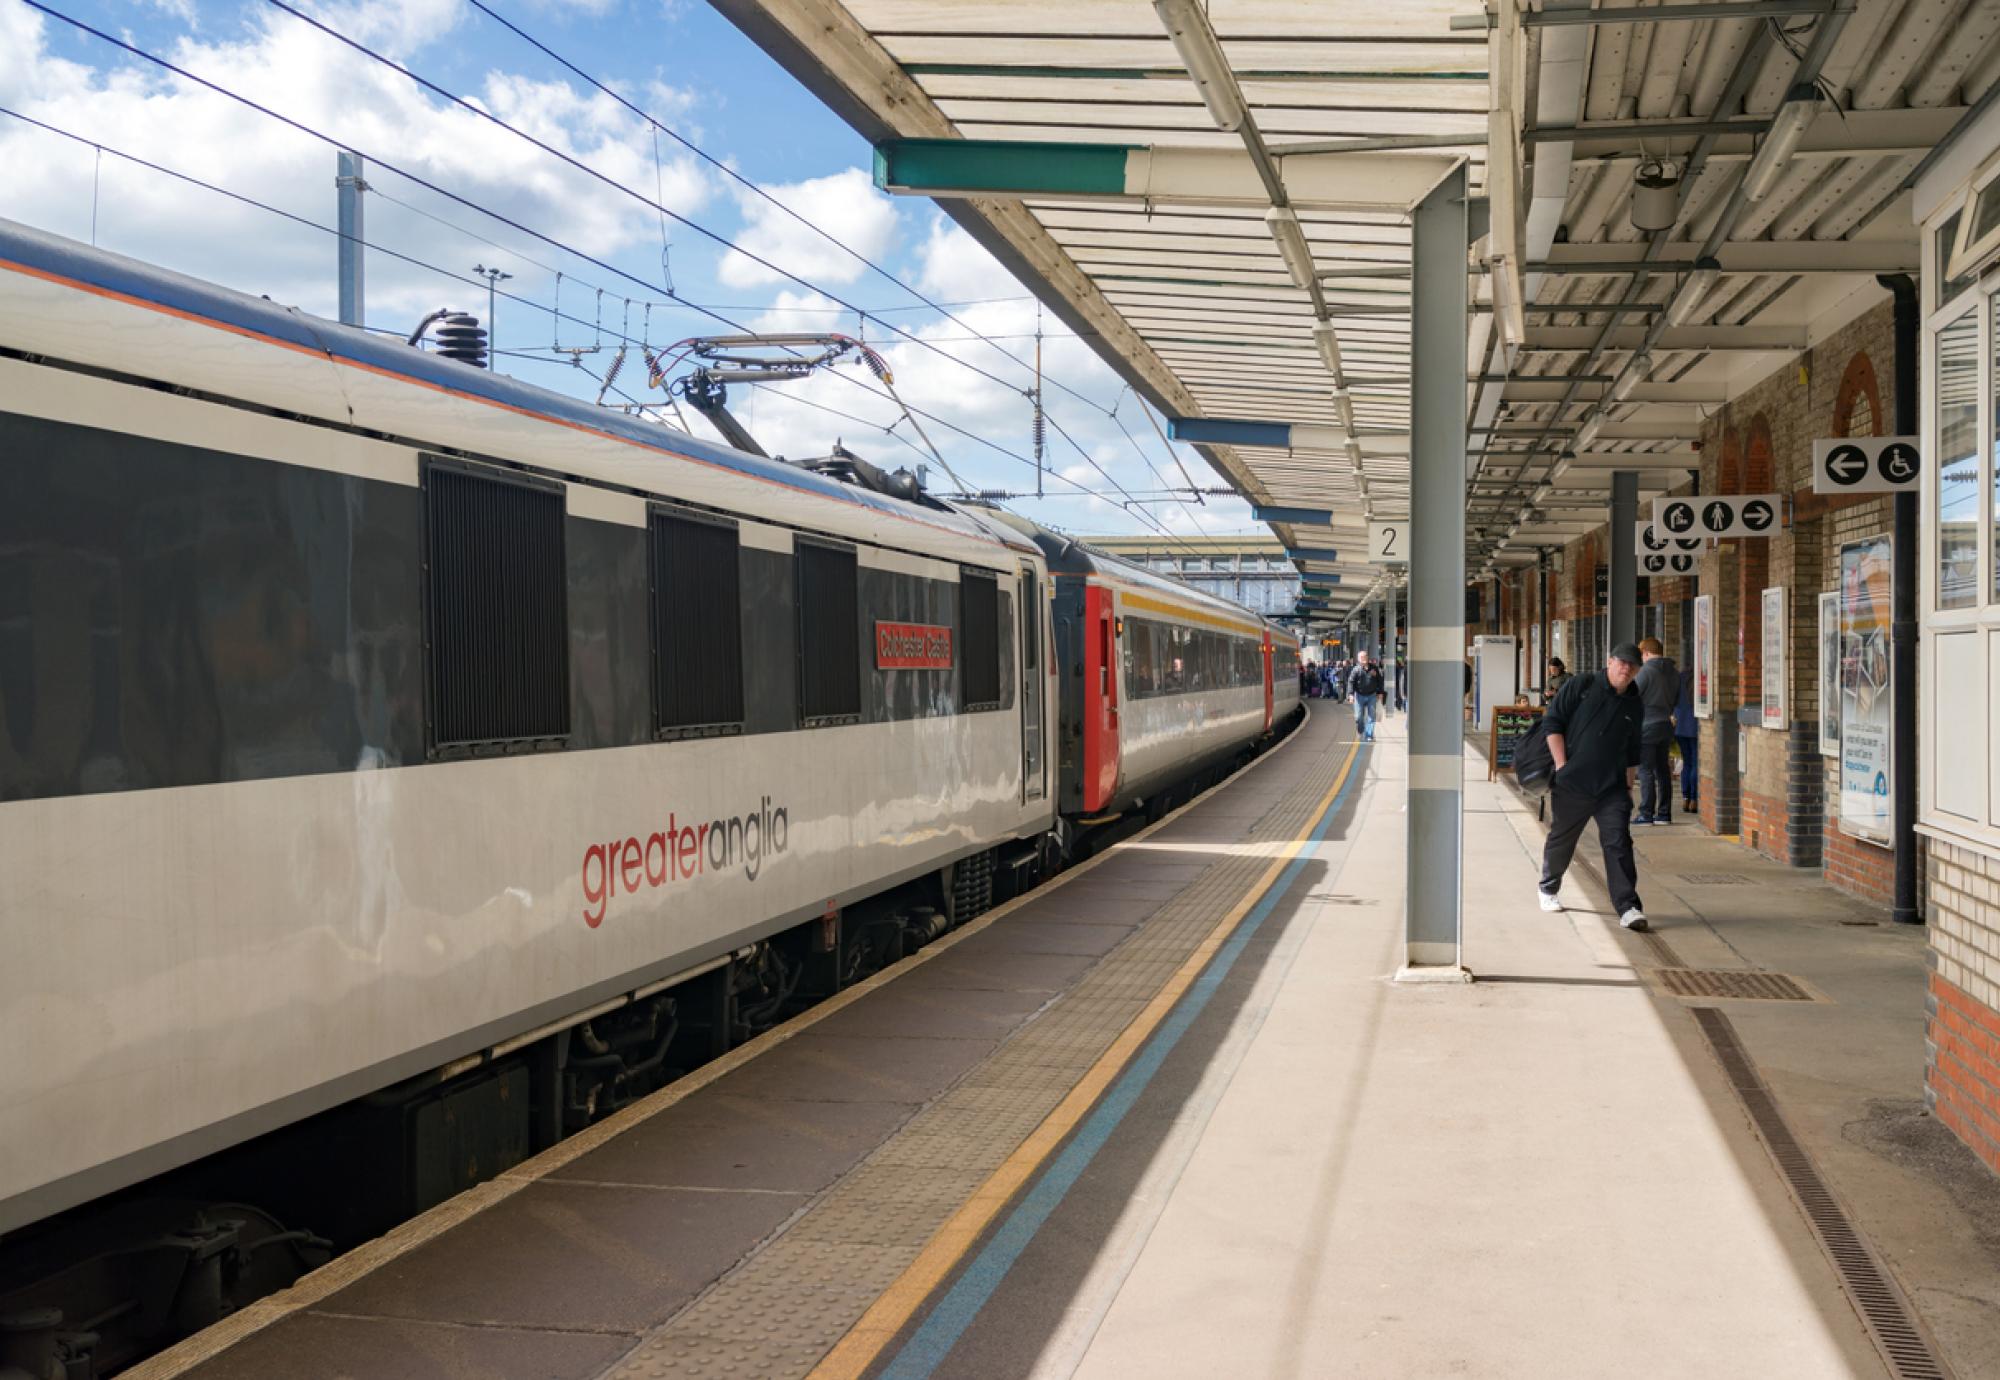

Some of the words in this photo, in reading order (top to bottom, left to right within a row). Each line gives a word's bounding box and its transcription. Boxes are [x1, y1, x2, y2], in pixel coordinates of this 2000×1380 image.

[1382, 527, 1396, 556] 2
[880, 629, 925, 657] Colchester
[926, 632, 950, 658] Castle
[582, 796, 788, 929] greateranglia
